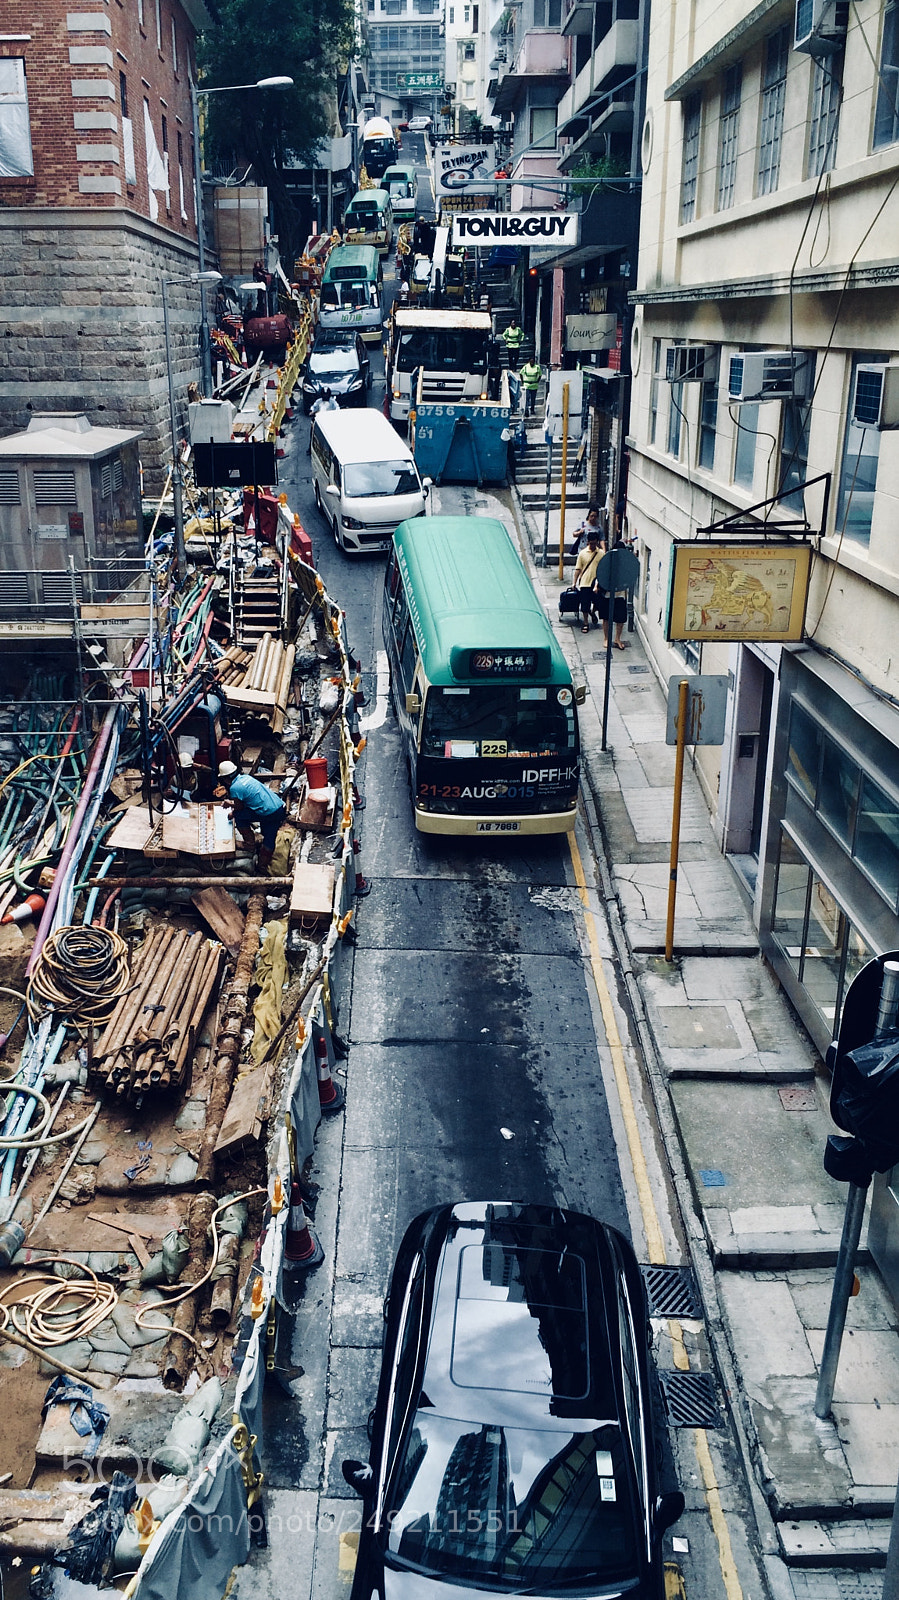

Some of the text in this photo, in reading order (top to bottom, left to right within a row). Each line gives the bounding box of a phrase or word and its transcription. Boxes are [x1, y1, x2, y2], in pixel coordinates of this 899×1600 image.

[441, 155, 471, 170] FLYING
[456, 216, 571, 236] TONI&GUY
[569, 326, 614, 344] lounge
[417, 406, 509, 418] 6756 7168
[476, 655, 492, 668] 22S
[482, 744, 507, 755] 22S
[522, 766, 578, 783] IDFFHK
[420, 784, 461, 798] 21-23
[460, 786, 497, 799] AUG
